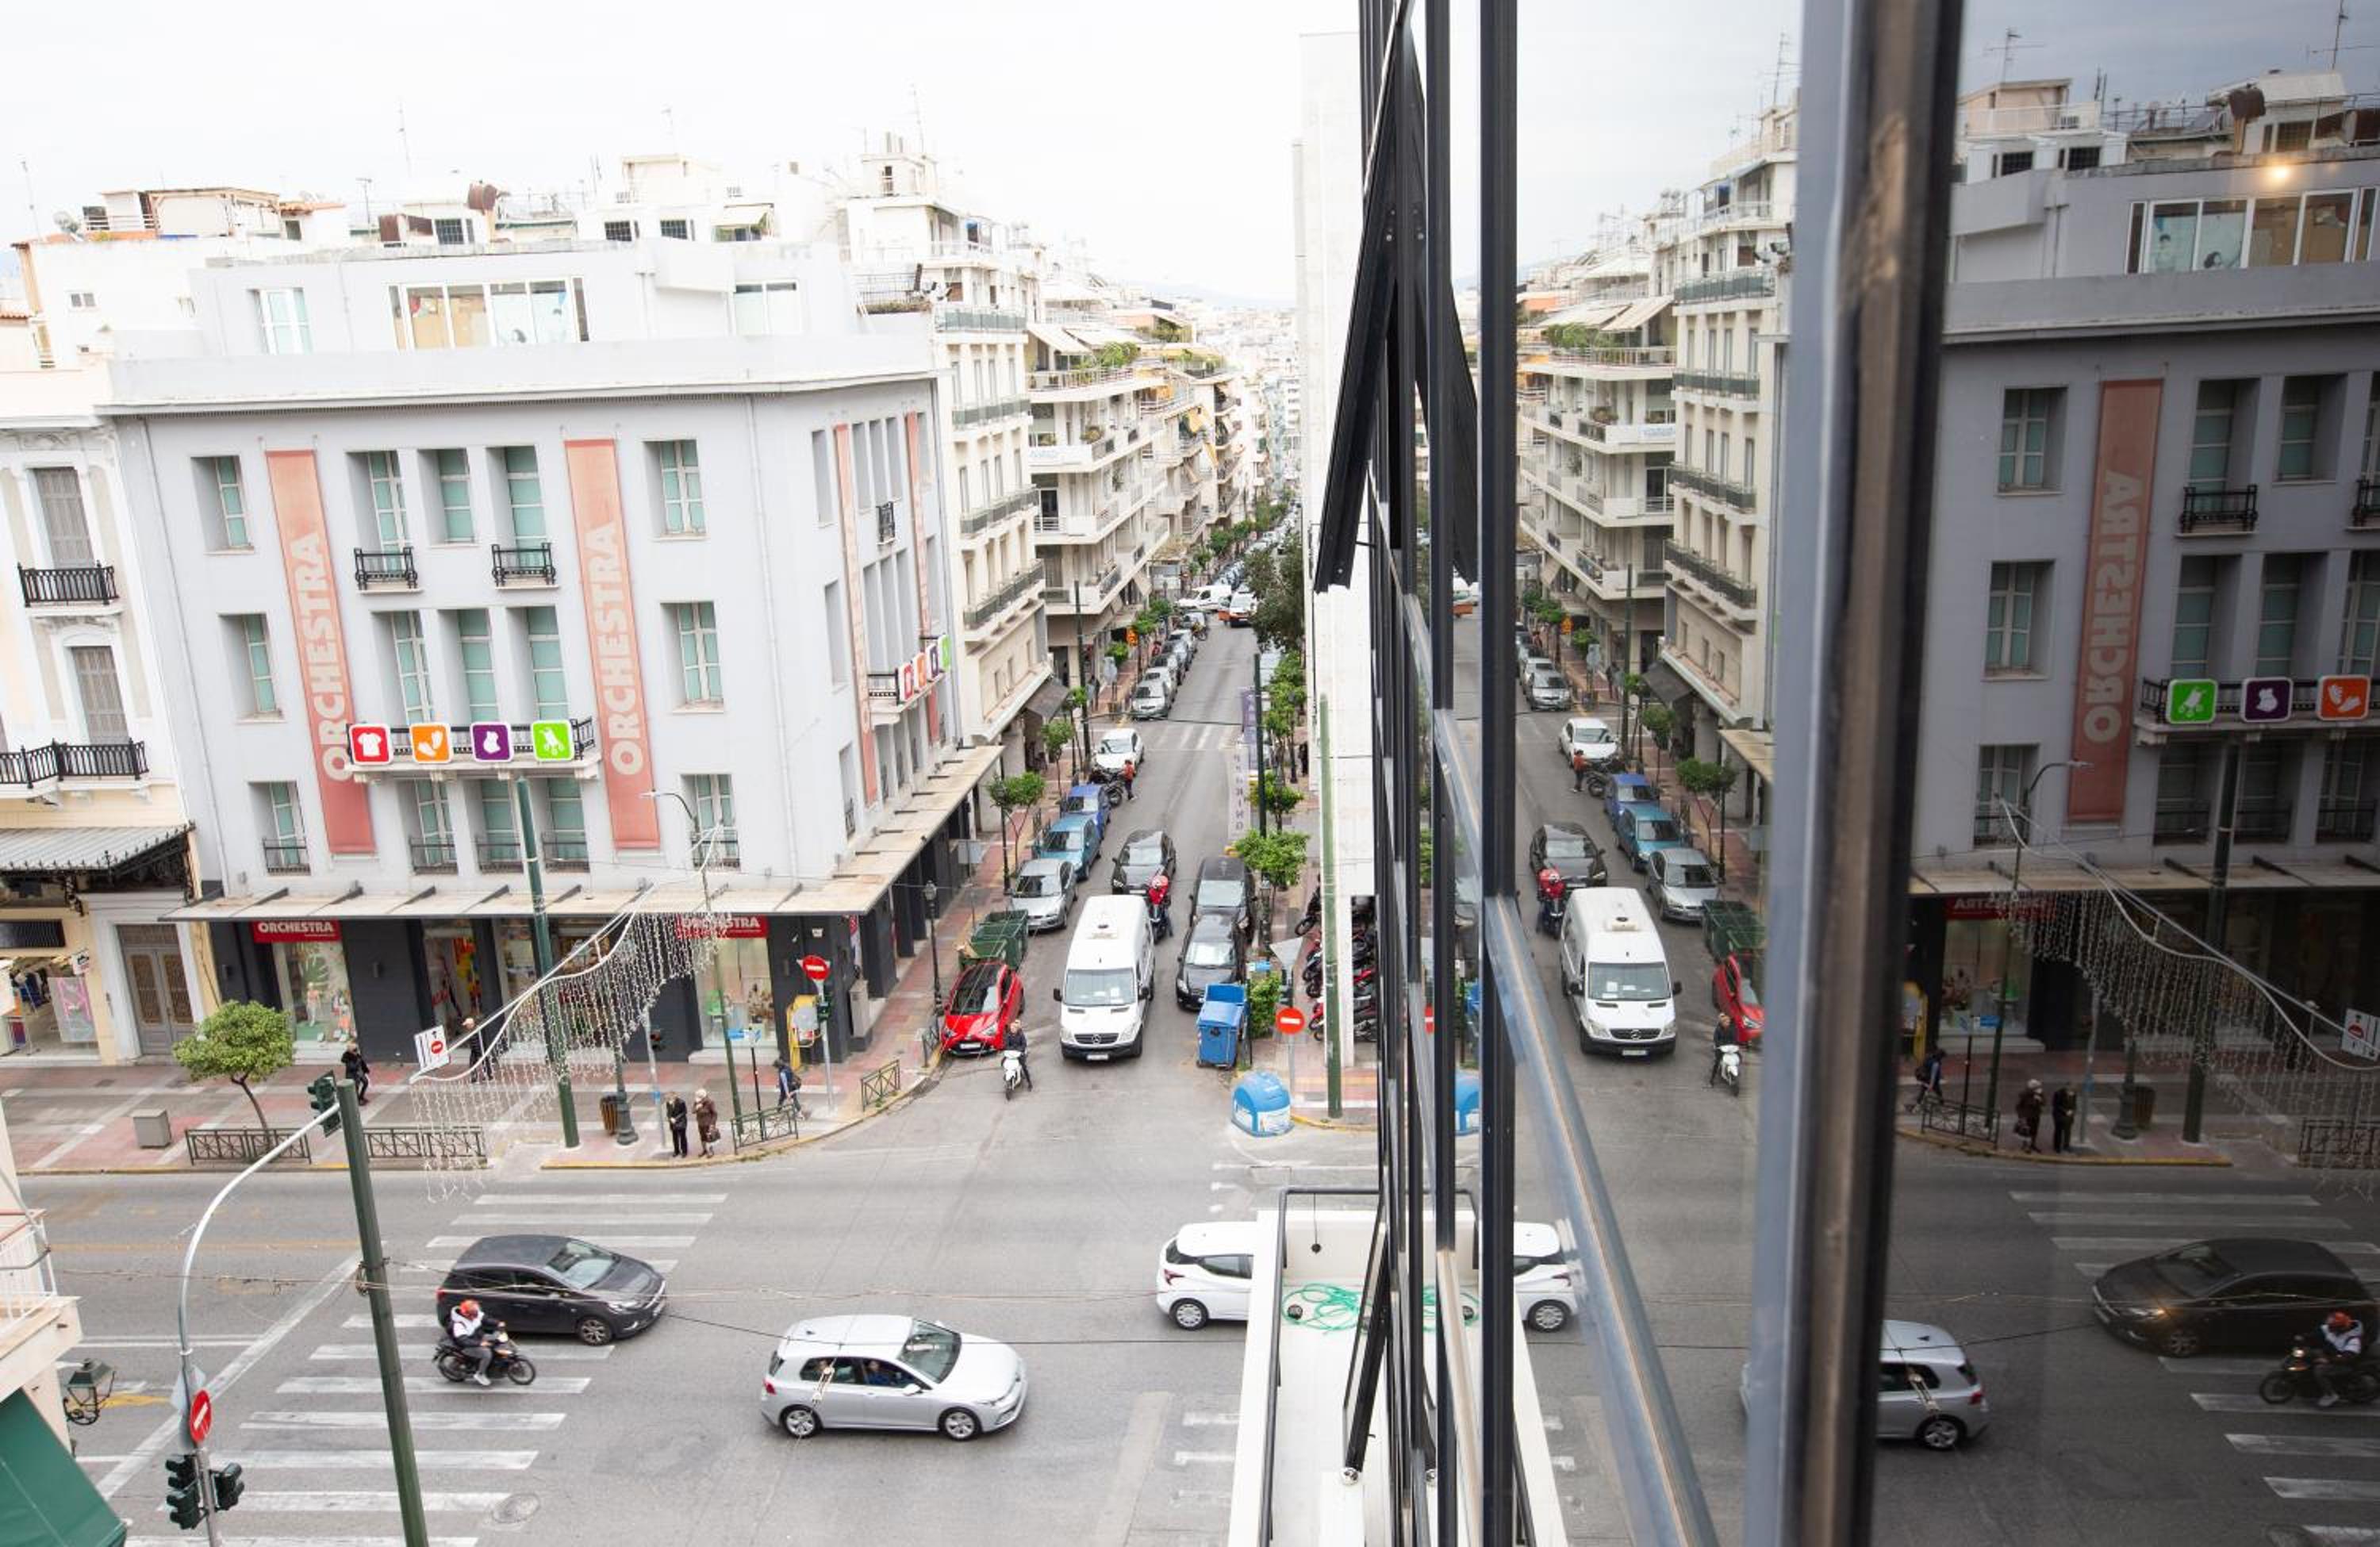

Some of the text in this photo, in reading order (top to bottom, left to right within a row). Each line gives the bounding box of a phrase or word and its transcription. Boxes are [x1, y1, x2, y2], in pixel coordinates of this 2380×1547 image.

[290, 533, 354, 782] ORCHESTRA
[584, 522, 643, 775] ORCHESTRA
[258, 921, 334, 933] ORCHESTRA
